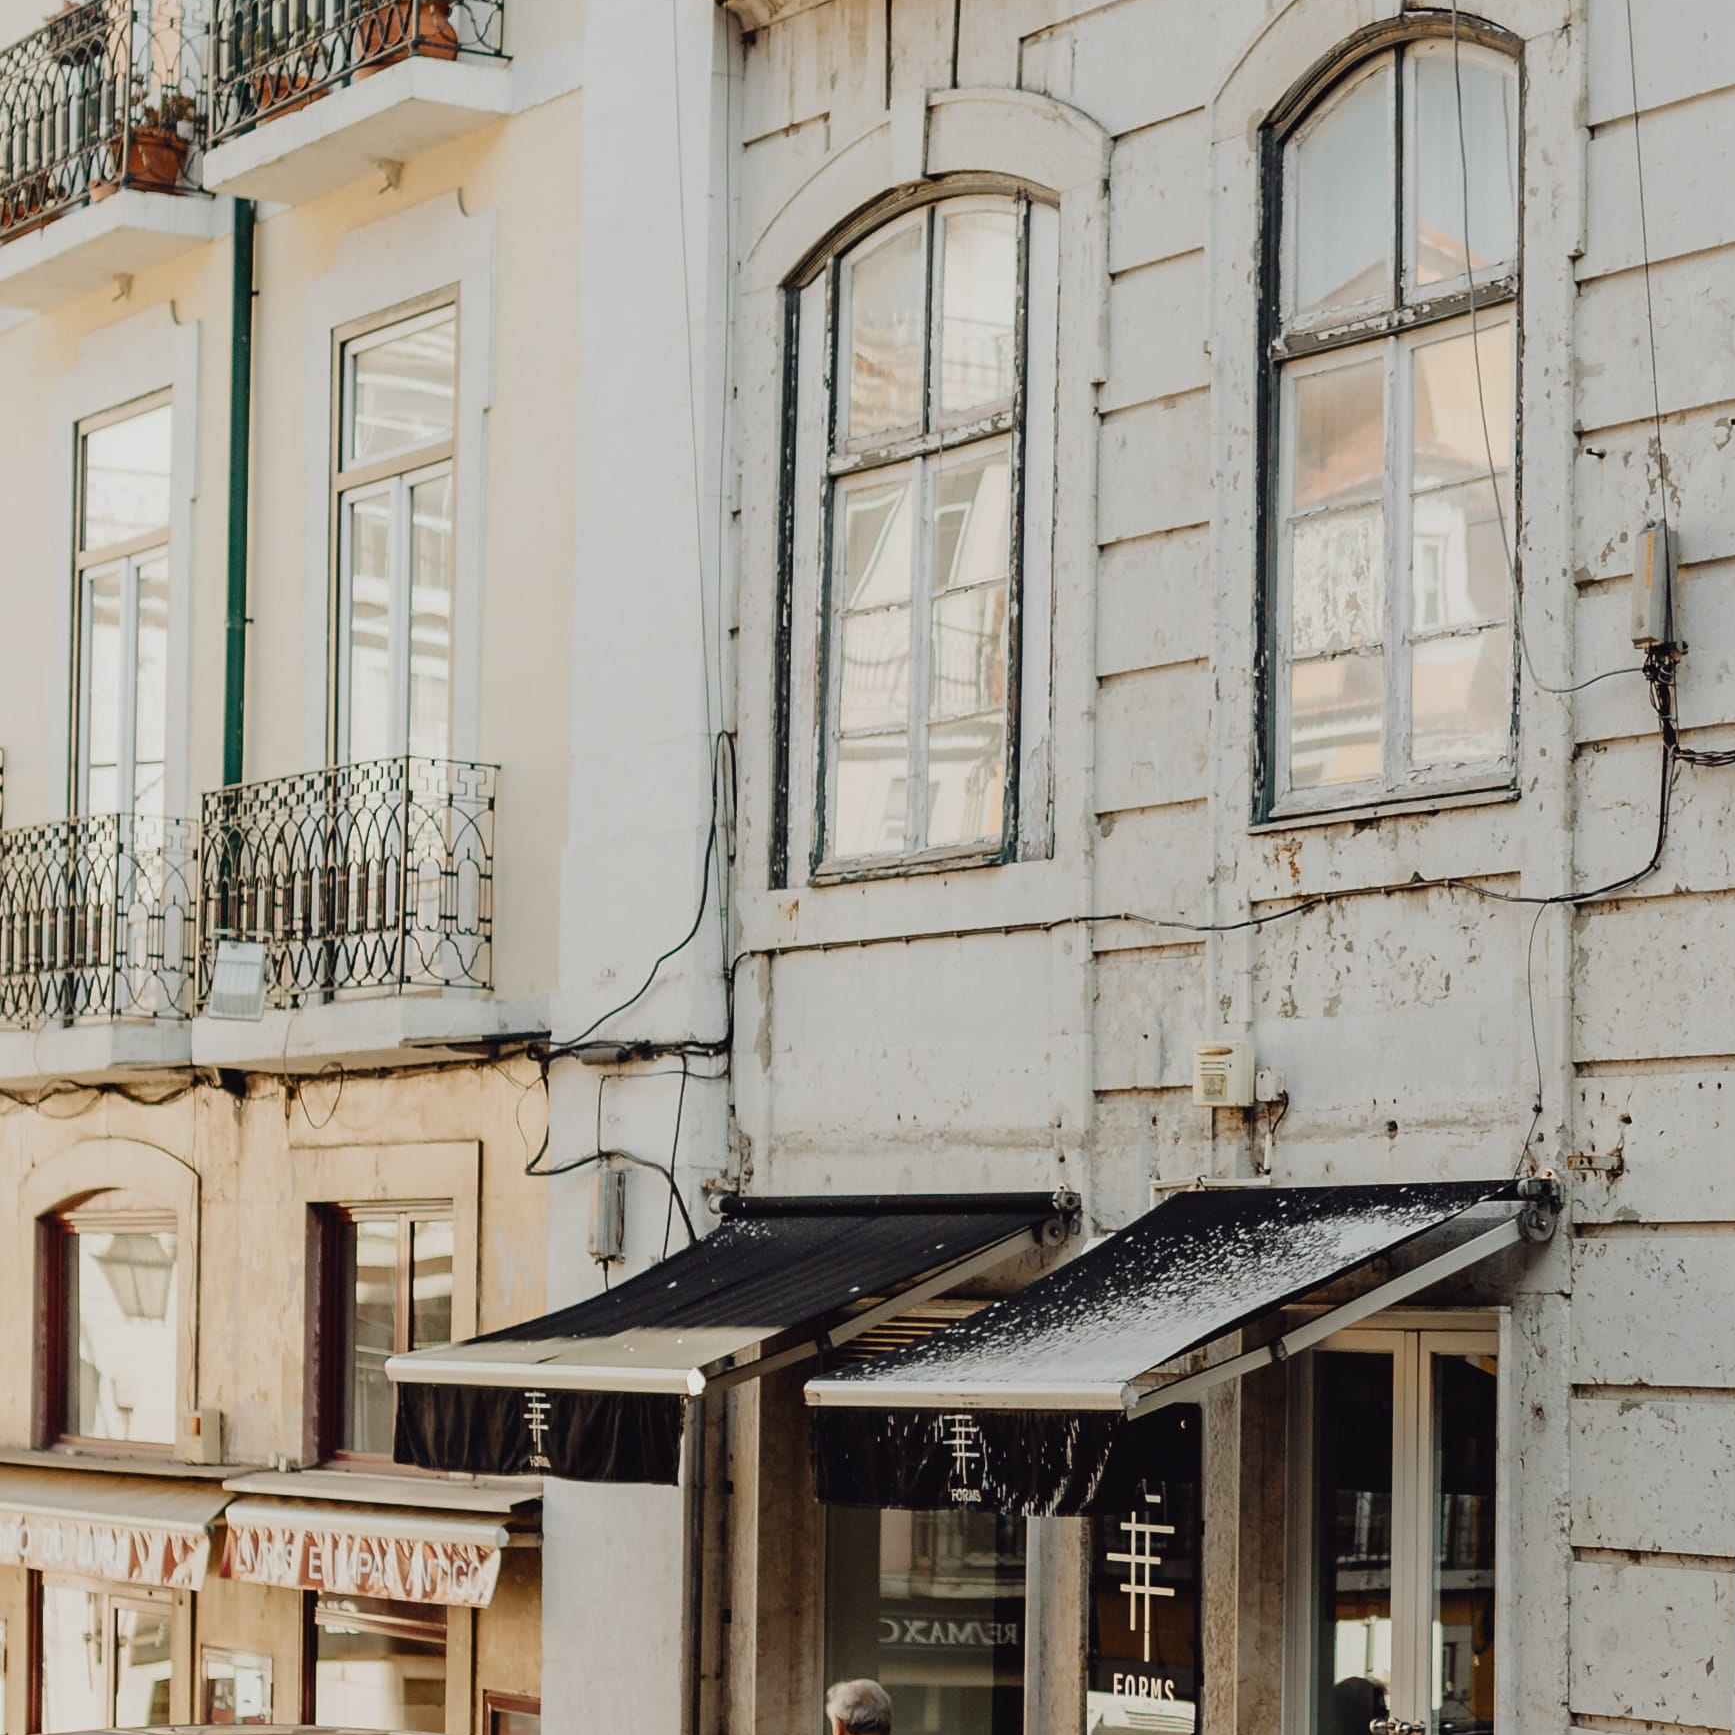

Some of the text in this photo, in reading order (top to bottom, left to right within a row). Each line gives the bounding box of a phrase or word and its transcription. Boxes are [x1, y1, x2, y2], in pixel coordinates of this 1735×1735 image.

[951, 1488, 982, 1502] FORMS
[308, 1546, 323, 1580] E
[1113, 1672, 1175, 1703] FORMS
